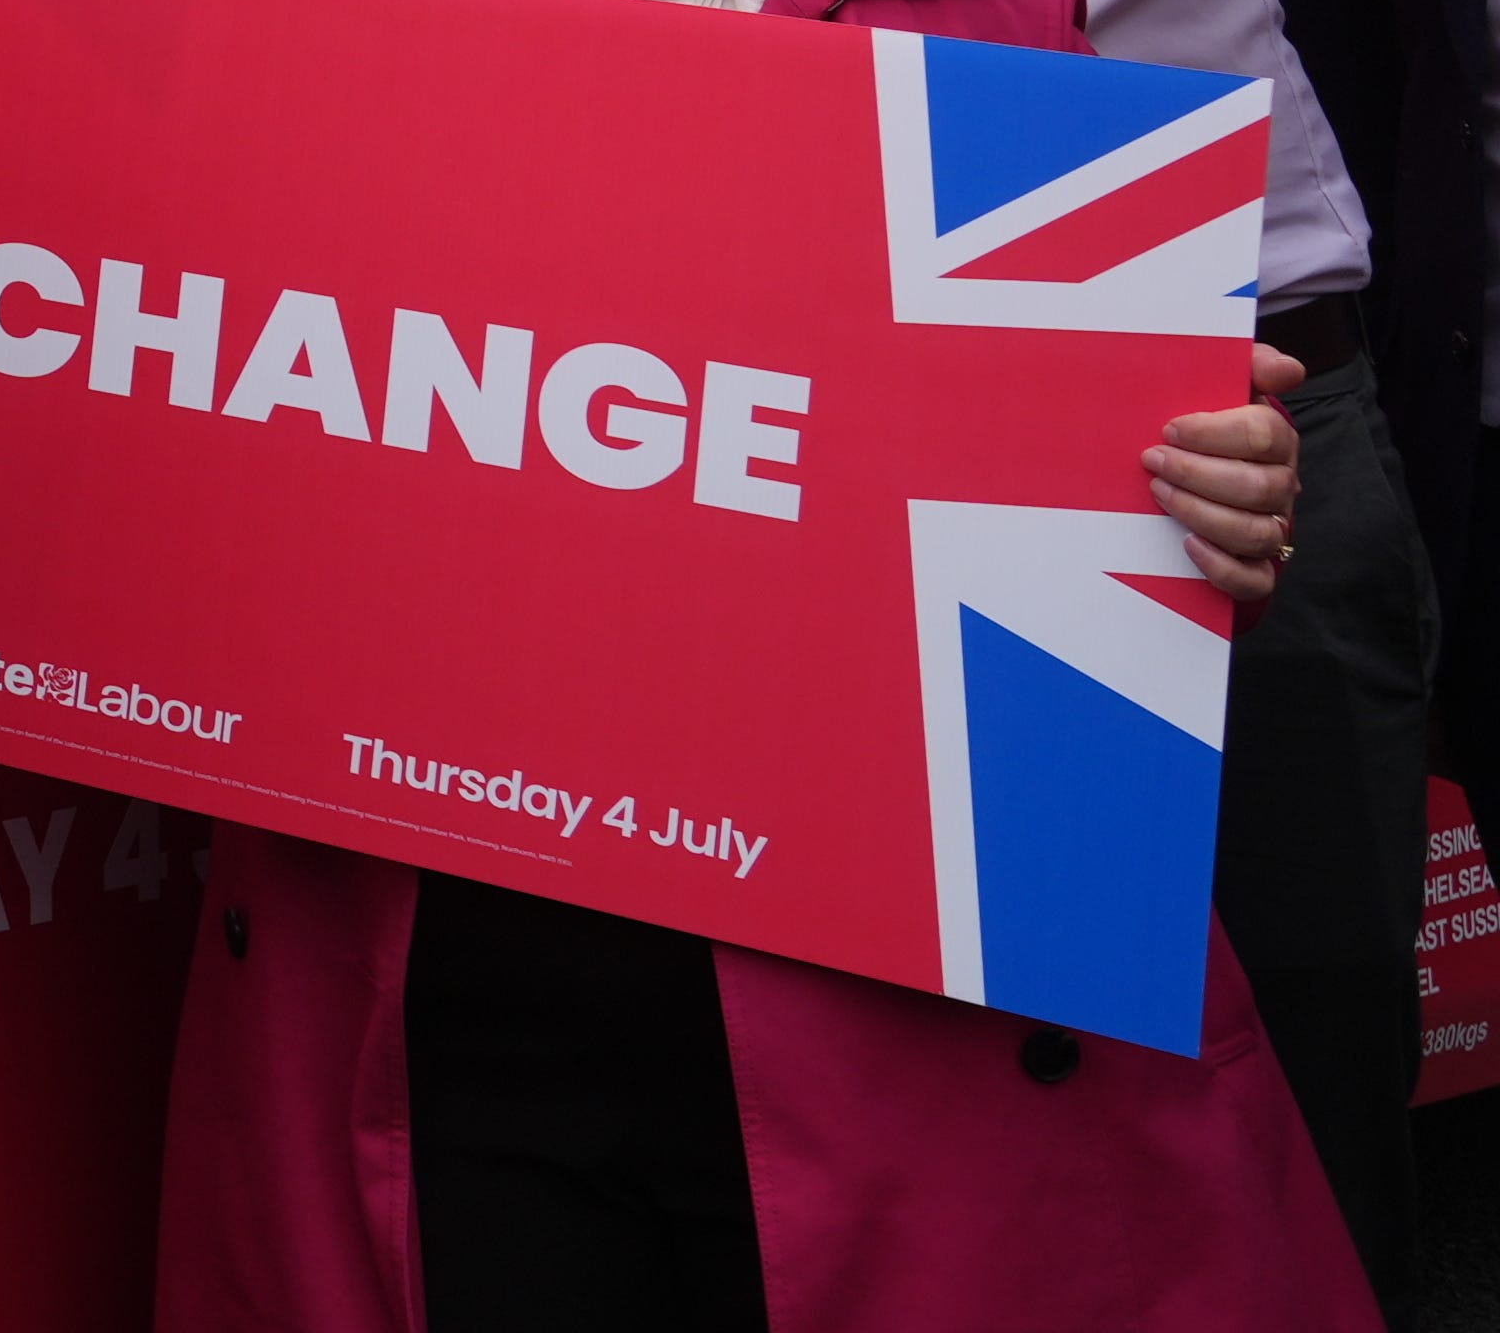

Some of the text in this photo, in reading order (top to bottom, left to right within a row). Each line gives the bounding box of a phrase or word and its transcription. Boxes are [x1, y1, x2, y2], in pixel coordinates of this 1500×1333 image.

[77, 672, 242, 743] Labour
[344, 734, 768, 878] Thursday 4 July
[104, 799, 169, 900] 4
[1425, 824, 1482, 863] SSING
[1422, 864, 1496, 909] HELSEA
[1420, 1021, 1489, 1057] 380kgs
